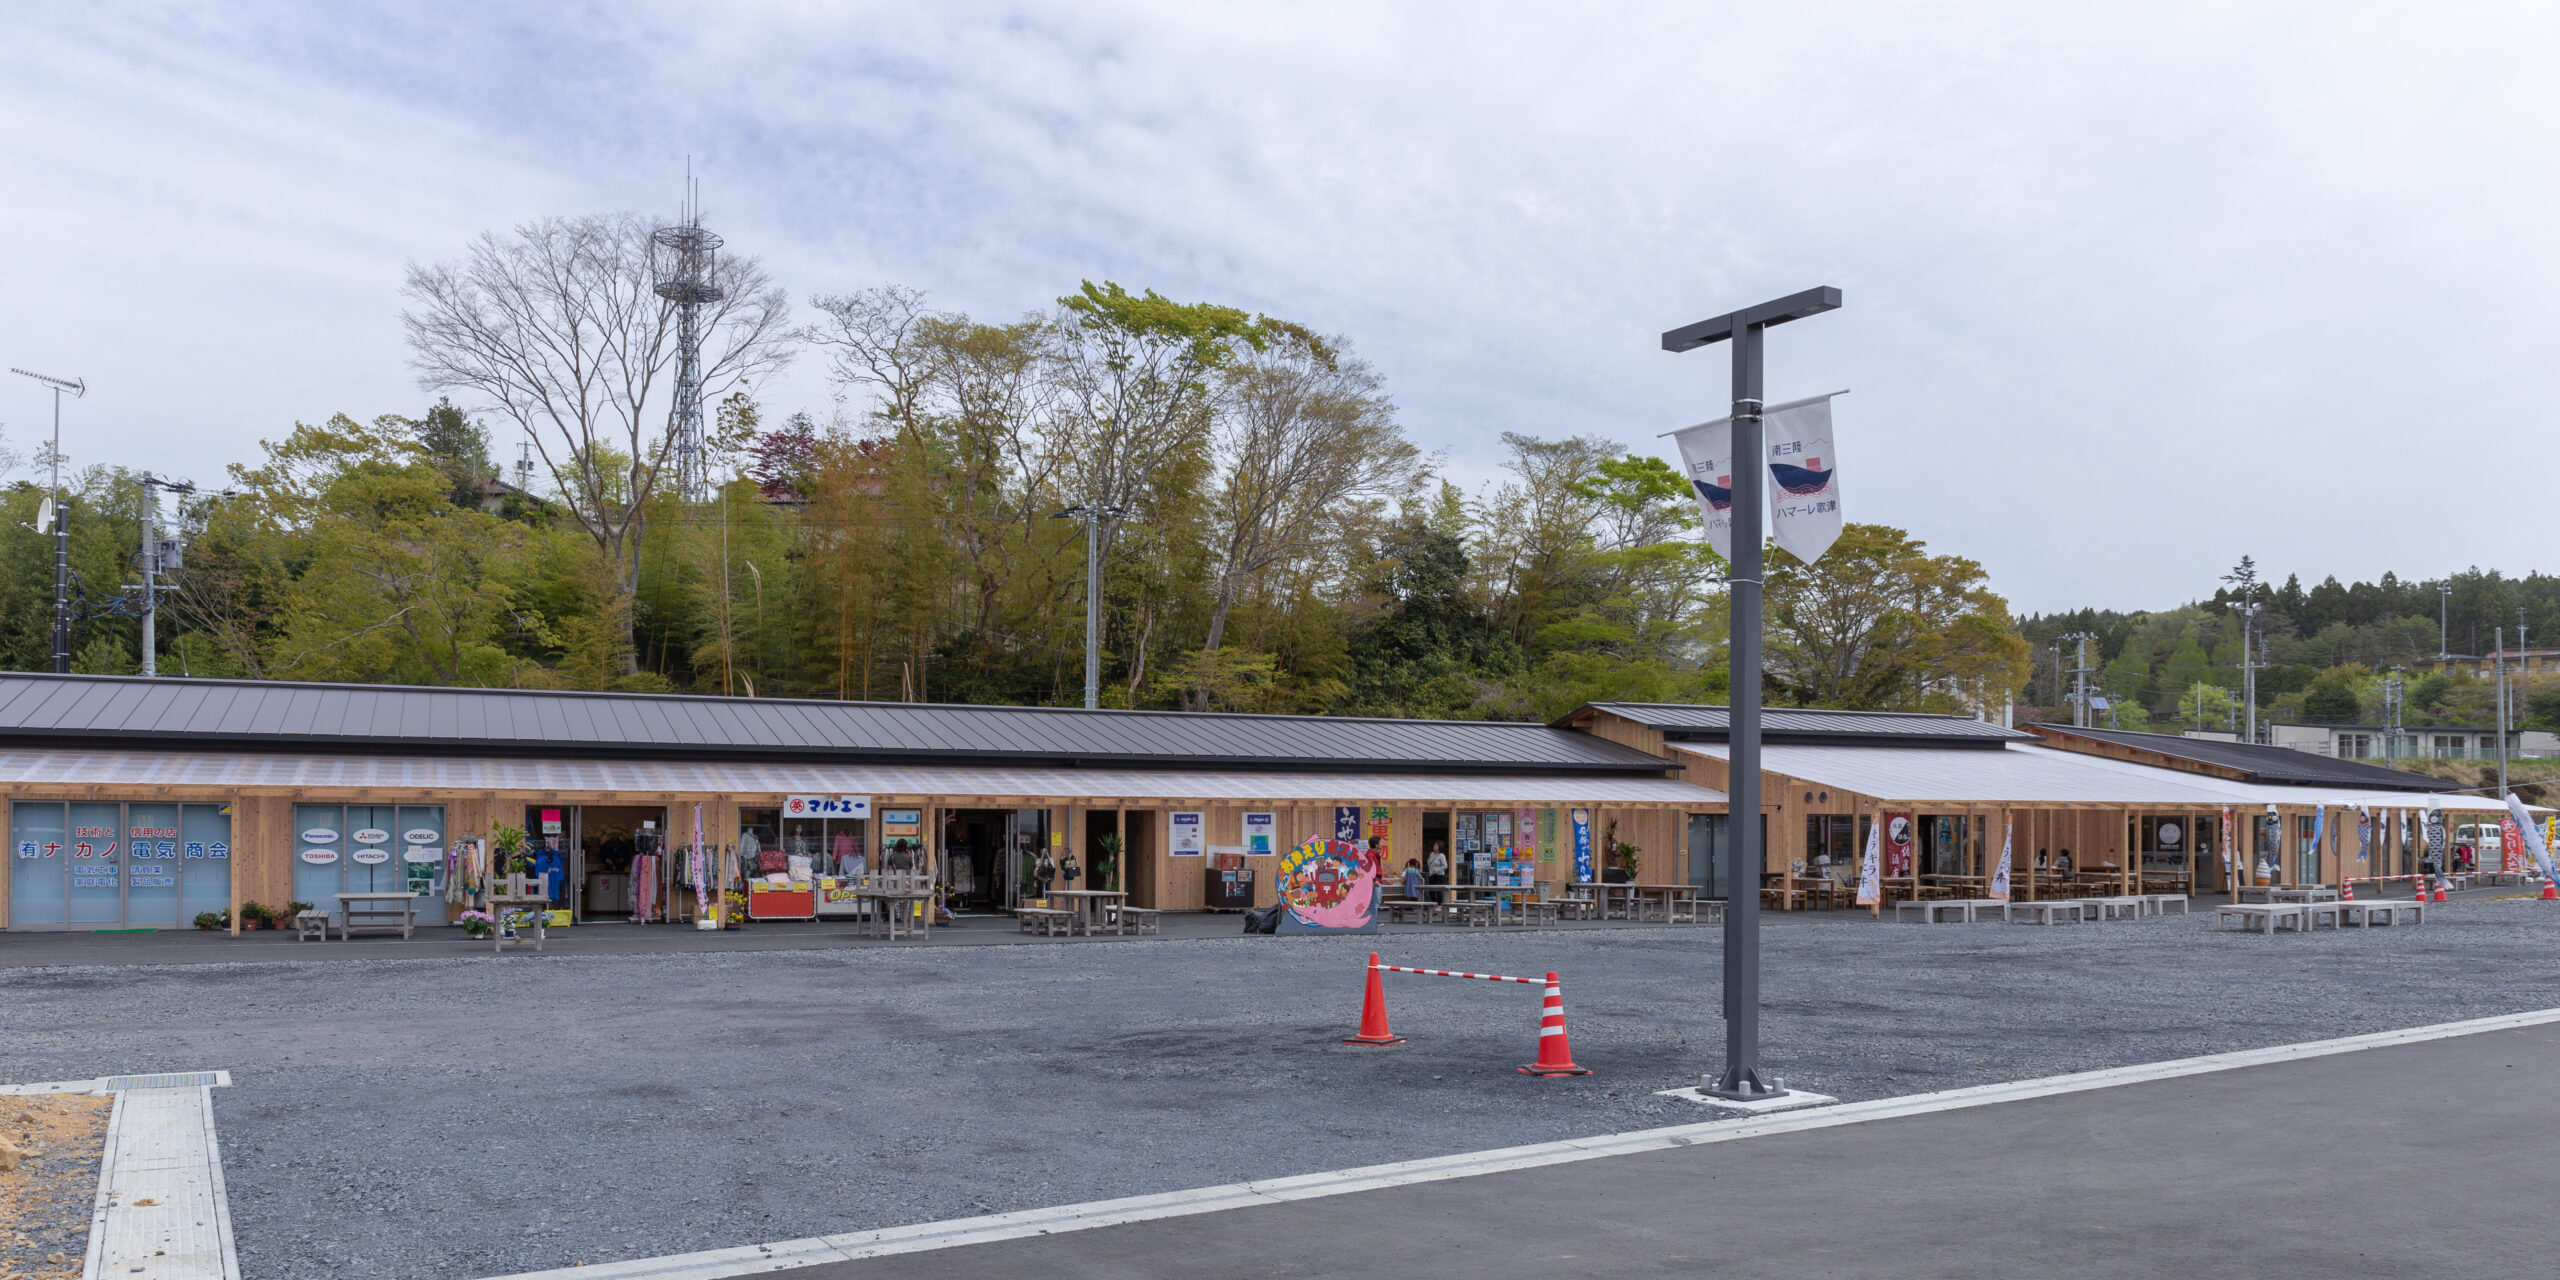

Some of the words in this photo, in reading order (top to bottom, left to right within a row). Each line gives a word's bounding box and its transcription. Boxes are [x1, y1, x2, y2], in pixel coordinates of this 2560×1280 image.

[1772, 441, 1802, 457] 南三陸
[1777, 500, 1836, 518] ハマーレ歌津
[808, 800, 865, 812] マルエー
